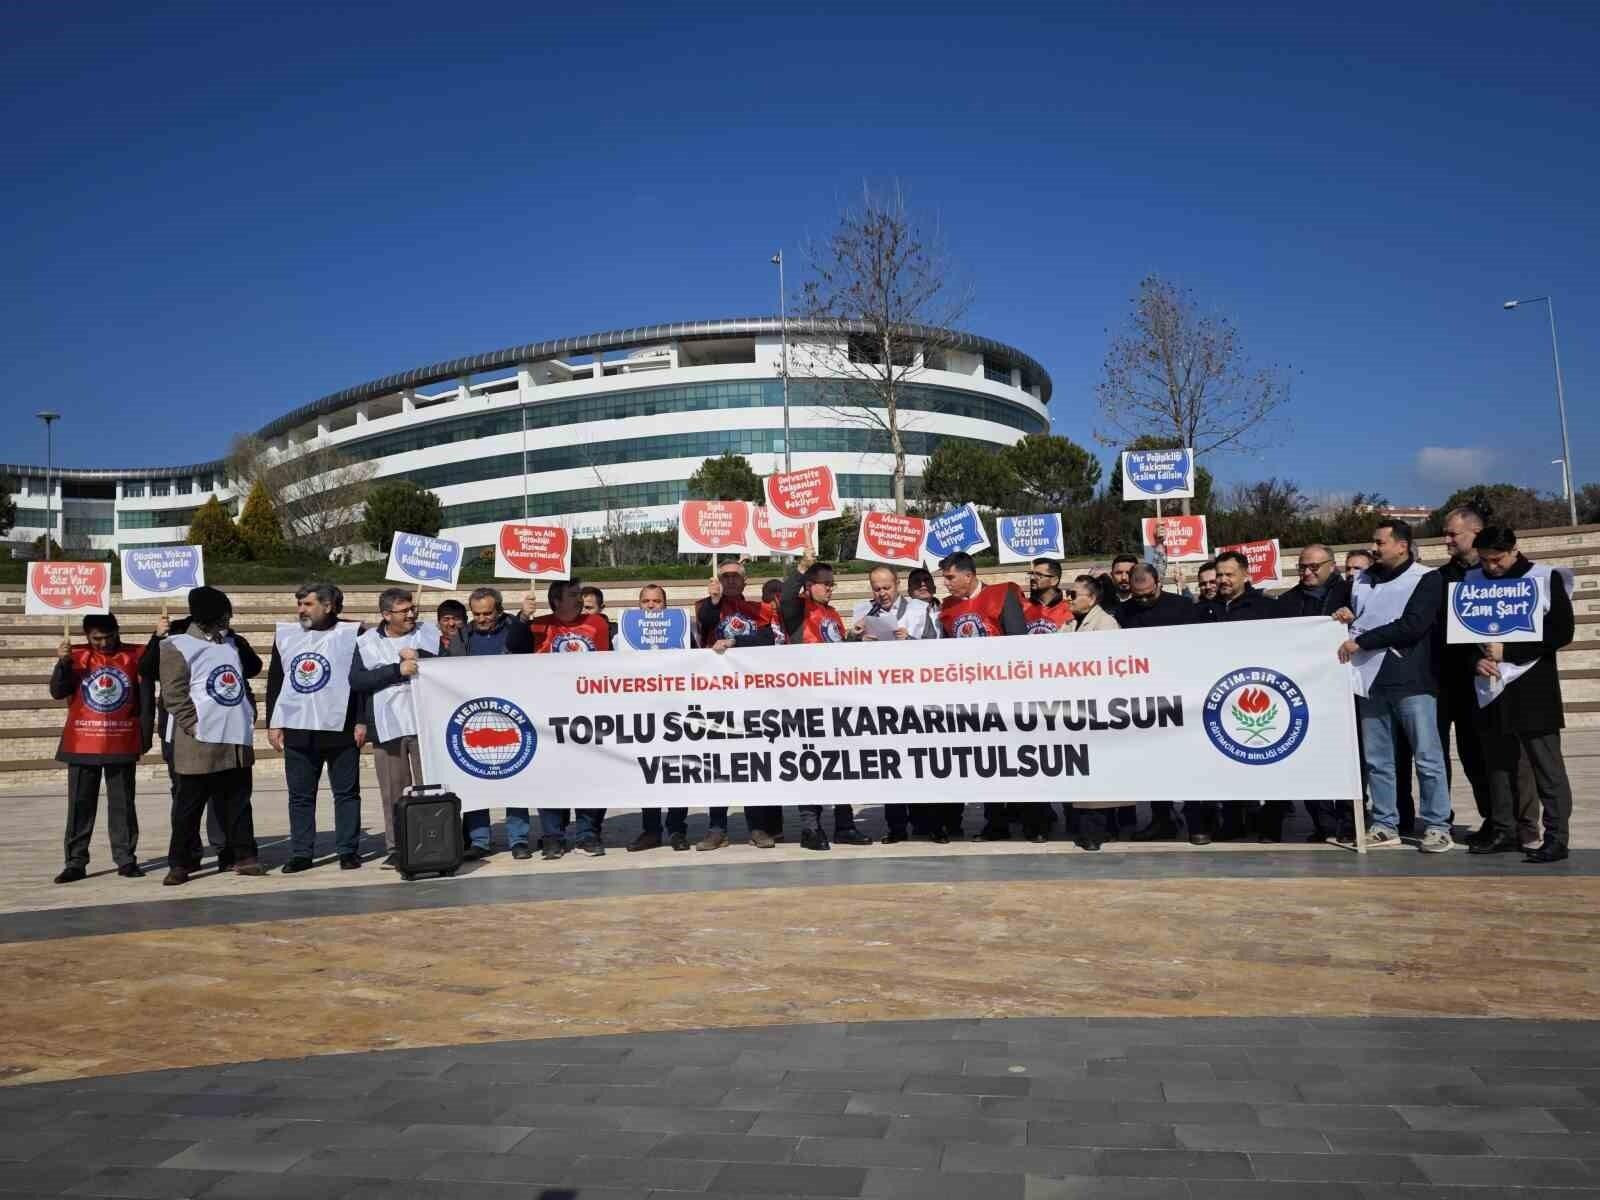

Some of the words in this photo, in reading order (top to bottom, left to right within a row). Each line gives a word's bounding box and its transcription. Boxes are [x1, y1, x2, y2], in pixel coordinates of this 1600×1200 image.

[1012, 517, 1045, 528] Verilen
[1013, 527, 1044, 538] Sözler
[404, 535, 422, 547] Aile
[1010, 537, 1050, 548] Tutulsun
[78, 566, 95, 575] Var
[153, 568, 173, 578] Var
[49, 576, 69, 585] Söz
[70, 576, 88, 585] Var
[1460, 582, 1531, 600] Akademik
[1461, 602, 1493, 617] Zam
[1495, 600, 1529, 619] Şart
[576, 673, 686, 695] ÜNİVERSİTE
[691, 671, 740, 691] İDARİ
[744, 666, 873, 690] PERSONELİNİN
[878, 667, 914, 685] YER
[919, 659, 1034, 685] DEĞİŞİKLİĞİ
[1039, 660, 1102, 680] HAKKI
[1107, 654, 1151, 678] İÇİN
[549, 712, 656, 746] TOPLU
[662, 704, 826, 744] SÖZLEŞME
[831, 702, 1008, 737] KARARINA
[1013, 695, 1185, 732] UYULSUN
[637, 751, 773, 785] VERİLEN
[778, 743, 902, 782] SÖZLER
[907, 743, 1091, 780] TUTULSUN
